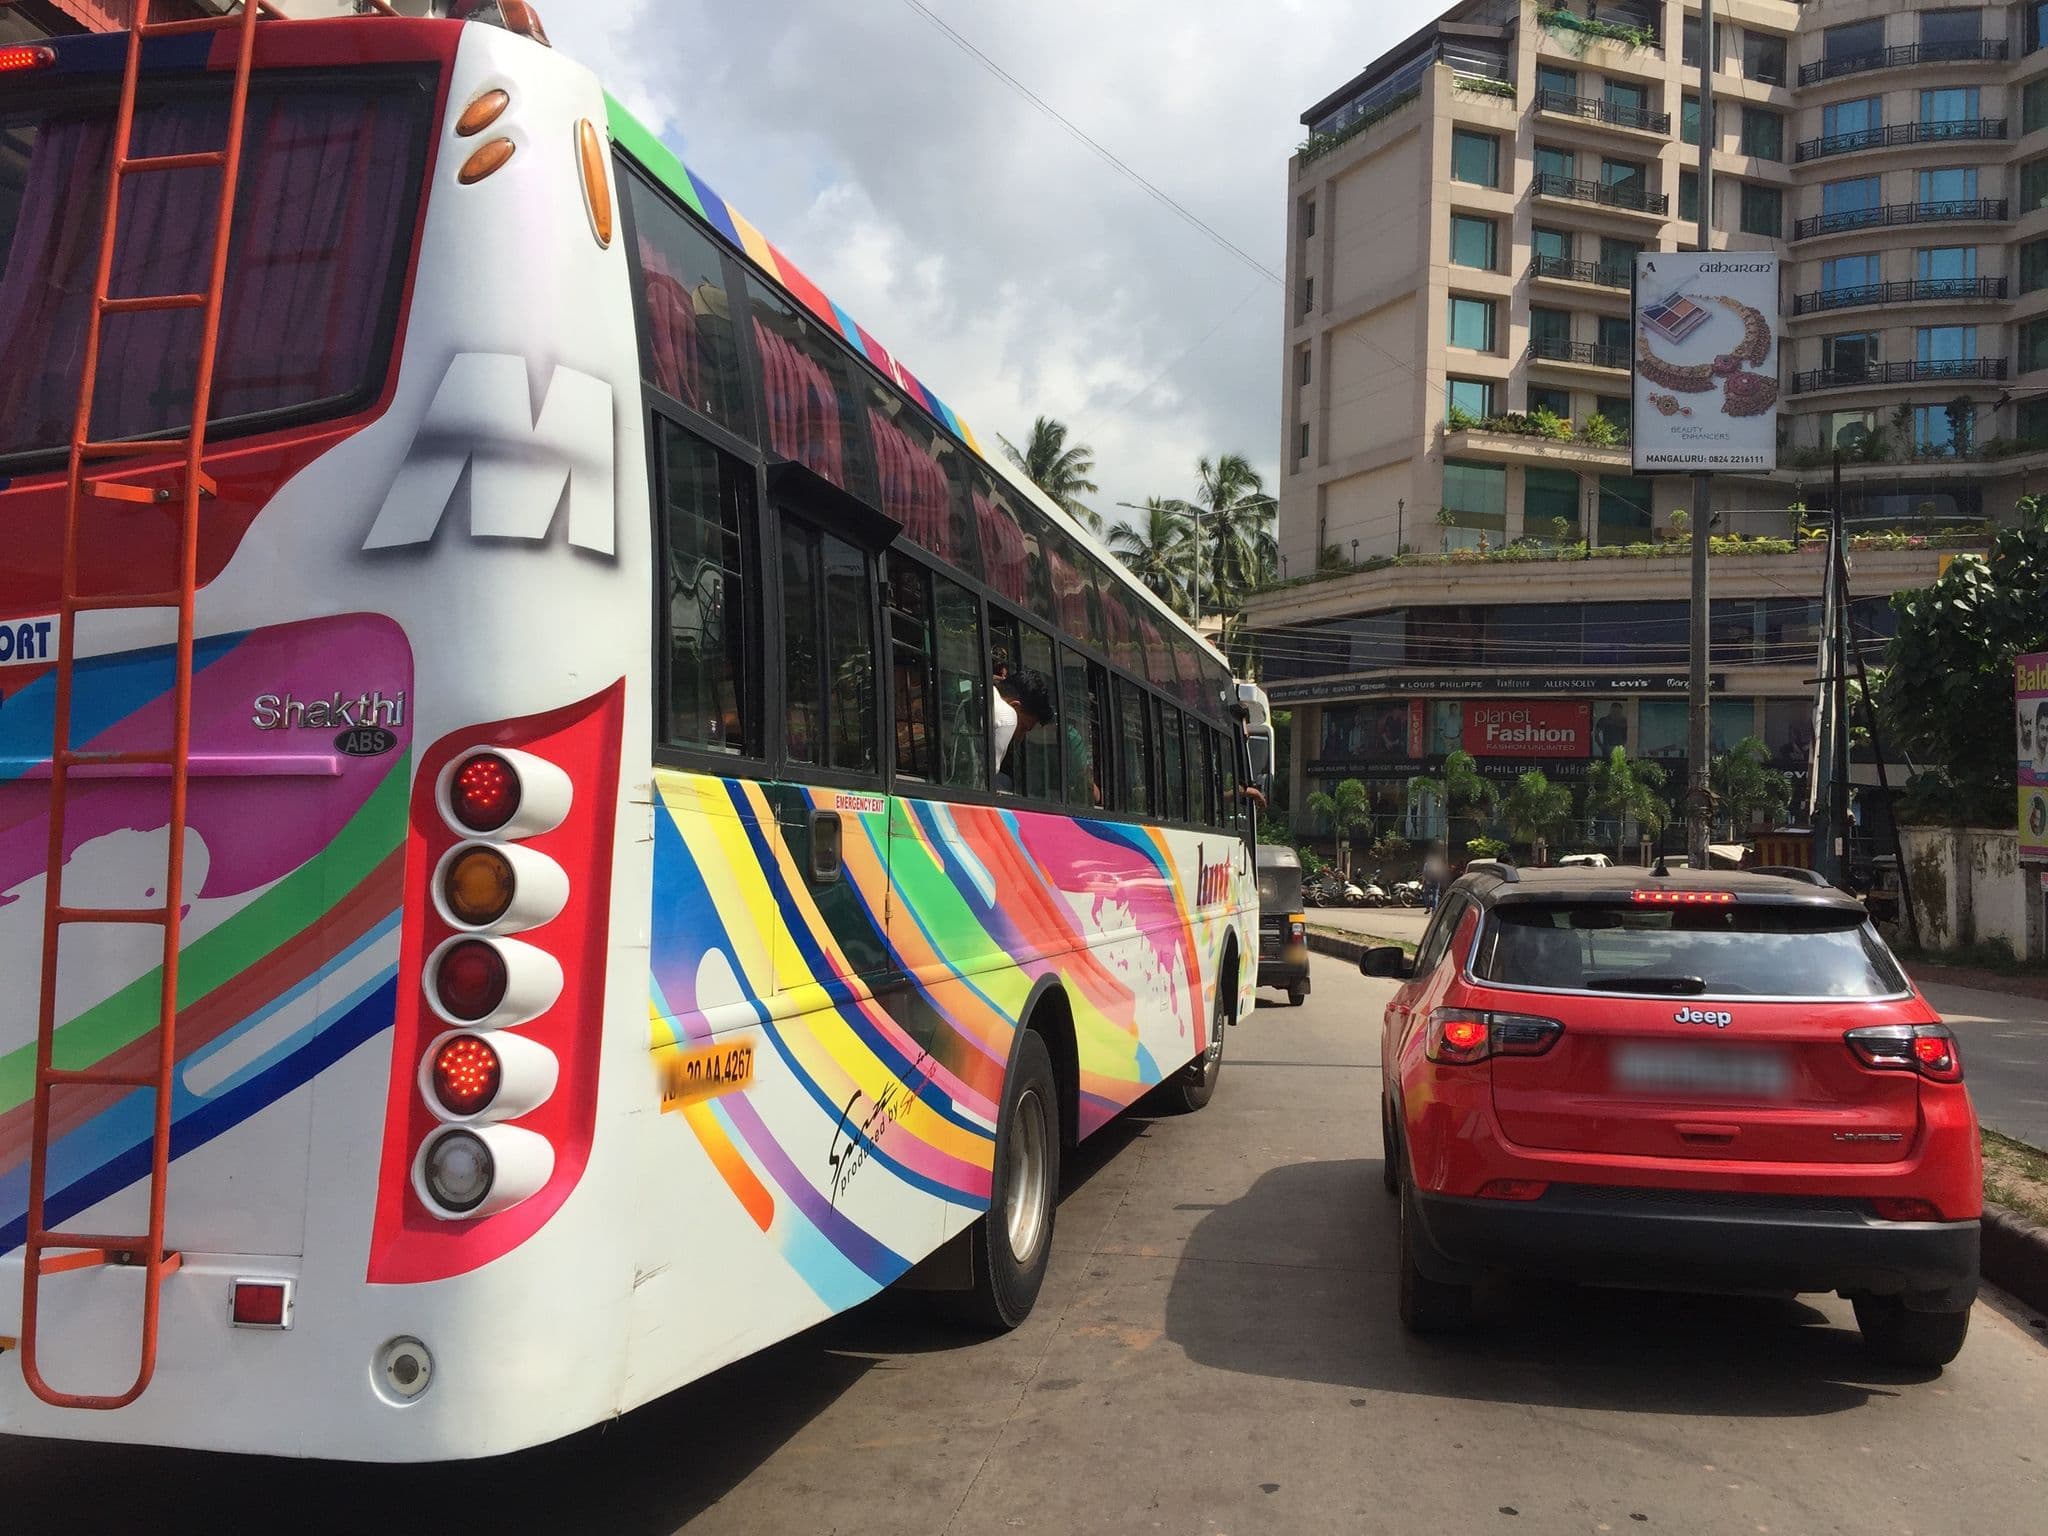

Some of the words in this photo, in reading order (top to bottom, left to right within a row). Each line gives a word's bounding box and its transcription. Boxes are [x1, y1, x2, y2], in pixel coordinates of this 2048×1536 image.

[1646, 455, 1706, 463] MANGALURU:
[1407, 681, 1435, 689] LOUIS
[1544, 679, 1570, 688] ALLEN
[1571, 679, 1597, 688] SOLLY
[251, 690, 406, 730] Shakthi
[1474, 708, 1532, 726] planet
[346, 731, 386, 752] ABS
[1487, 721, 1576, 742] Fashion
[836, 795, 871, 810] EMERGENCY
[872, 799, 884, 812] EXIT
[1674, 1006, 1733, 1029] Jeep
[840, 1117, 886, 1197] produced
